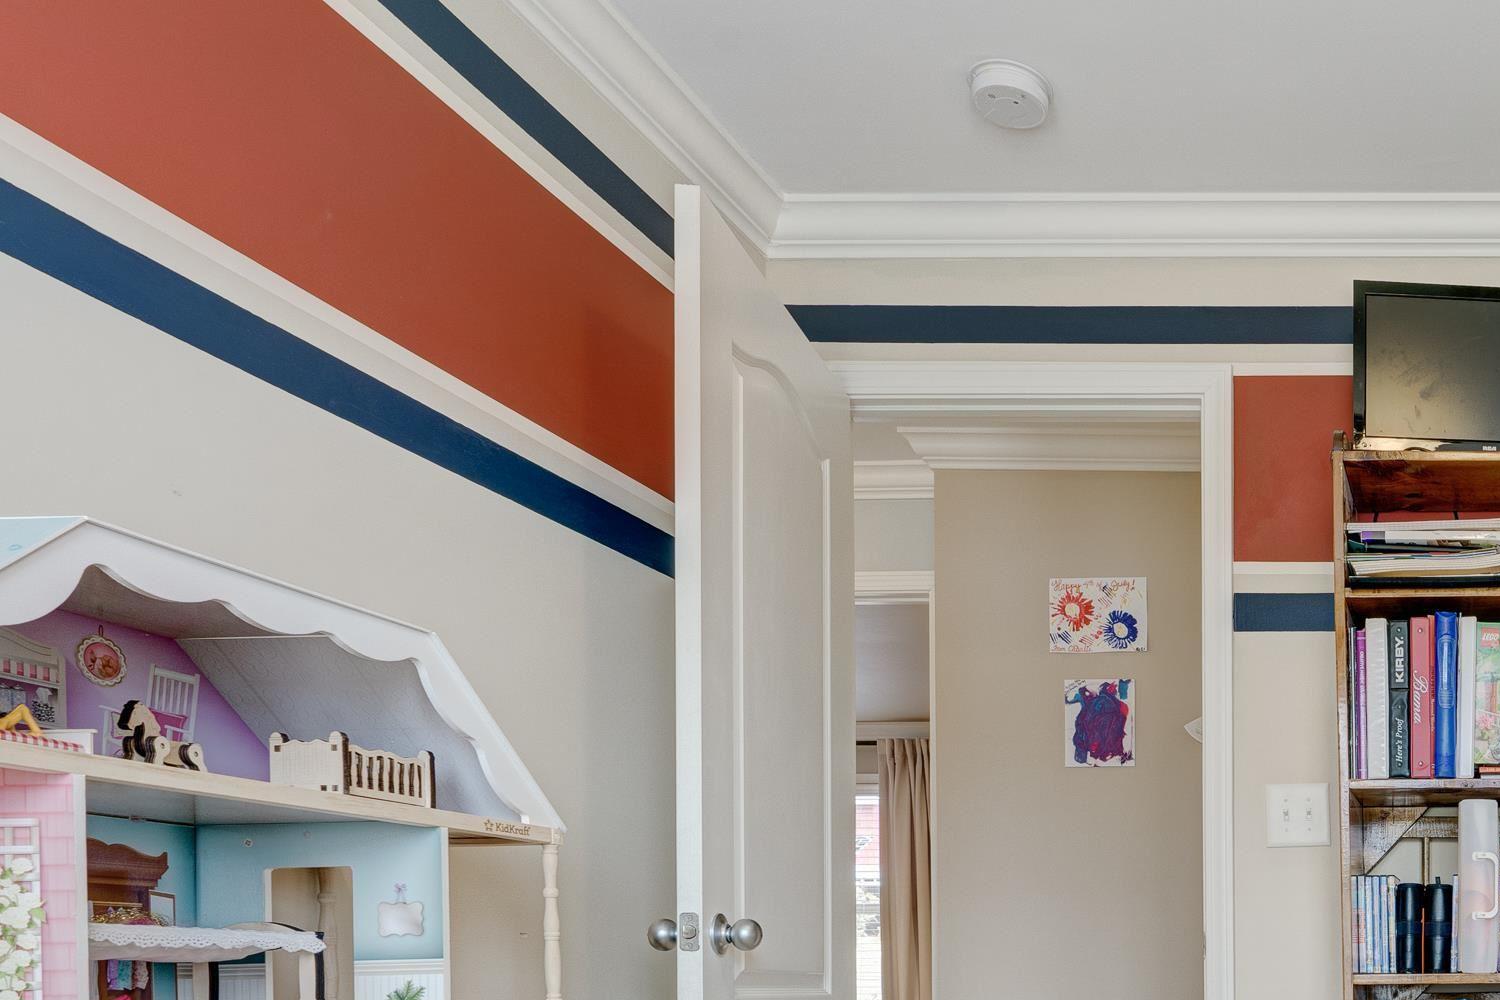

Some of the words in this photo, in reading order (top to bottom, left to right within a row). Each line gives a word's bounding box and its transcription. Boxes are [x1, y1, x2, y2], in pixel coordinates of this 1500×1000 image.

[1483, 632, 1499, 641] LEGO
[1413, 669, 1429, 725] Bama
[1396, 716, 1405, 737] Proof
[1395, 736, 1404, 763] Here's
[495, 822, 530, 836] KidKraft
